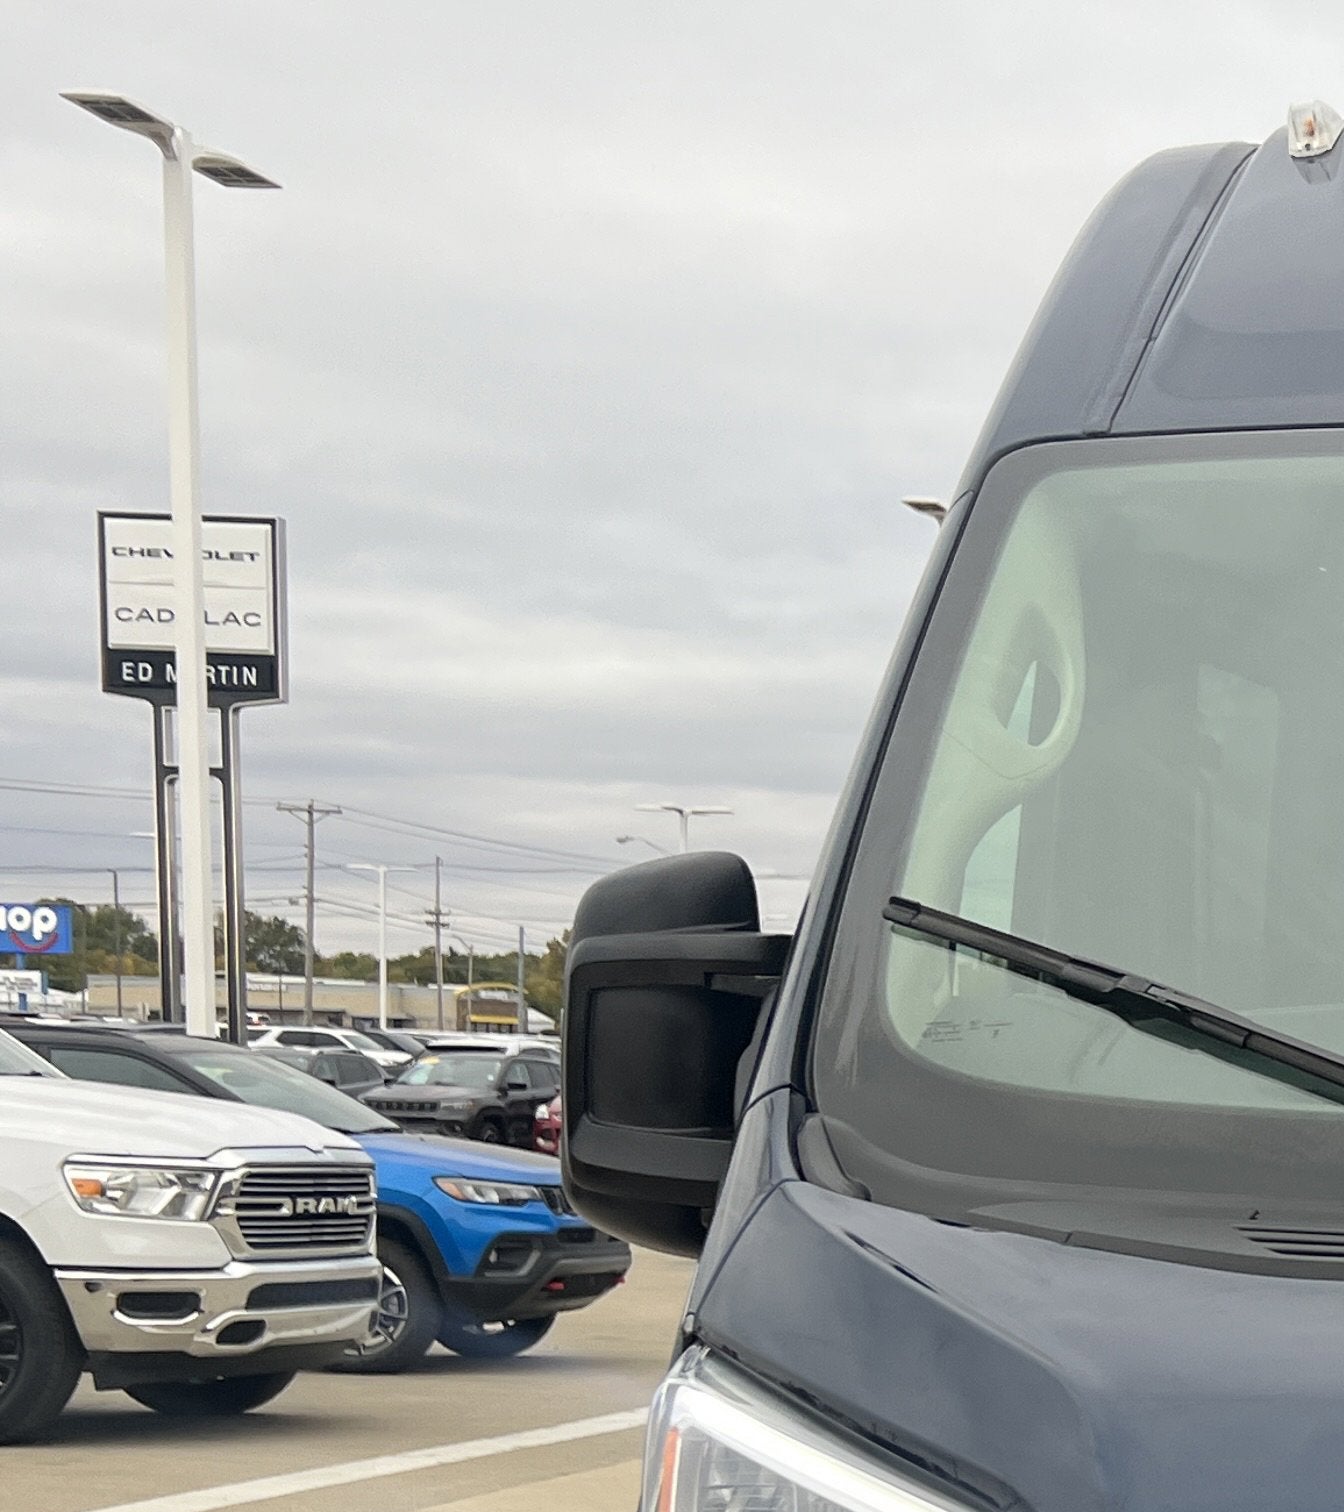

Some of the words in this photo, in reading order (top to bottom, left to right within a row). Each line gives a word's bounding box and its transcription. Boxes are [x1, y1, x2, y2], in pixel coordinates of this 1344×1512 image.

[115, 606, 261, 627] CADLAC
[121, 661, 153, 682] ED
[165, 661, 258, 686] MRTIN
[296, 1196, 350, 1214] RAM
